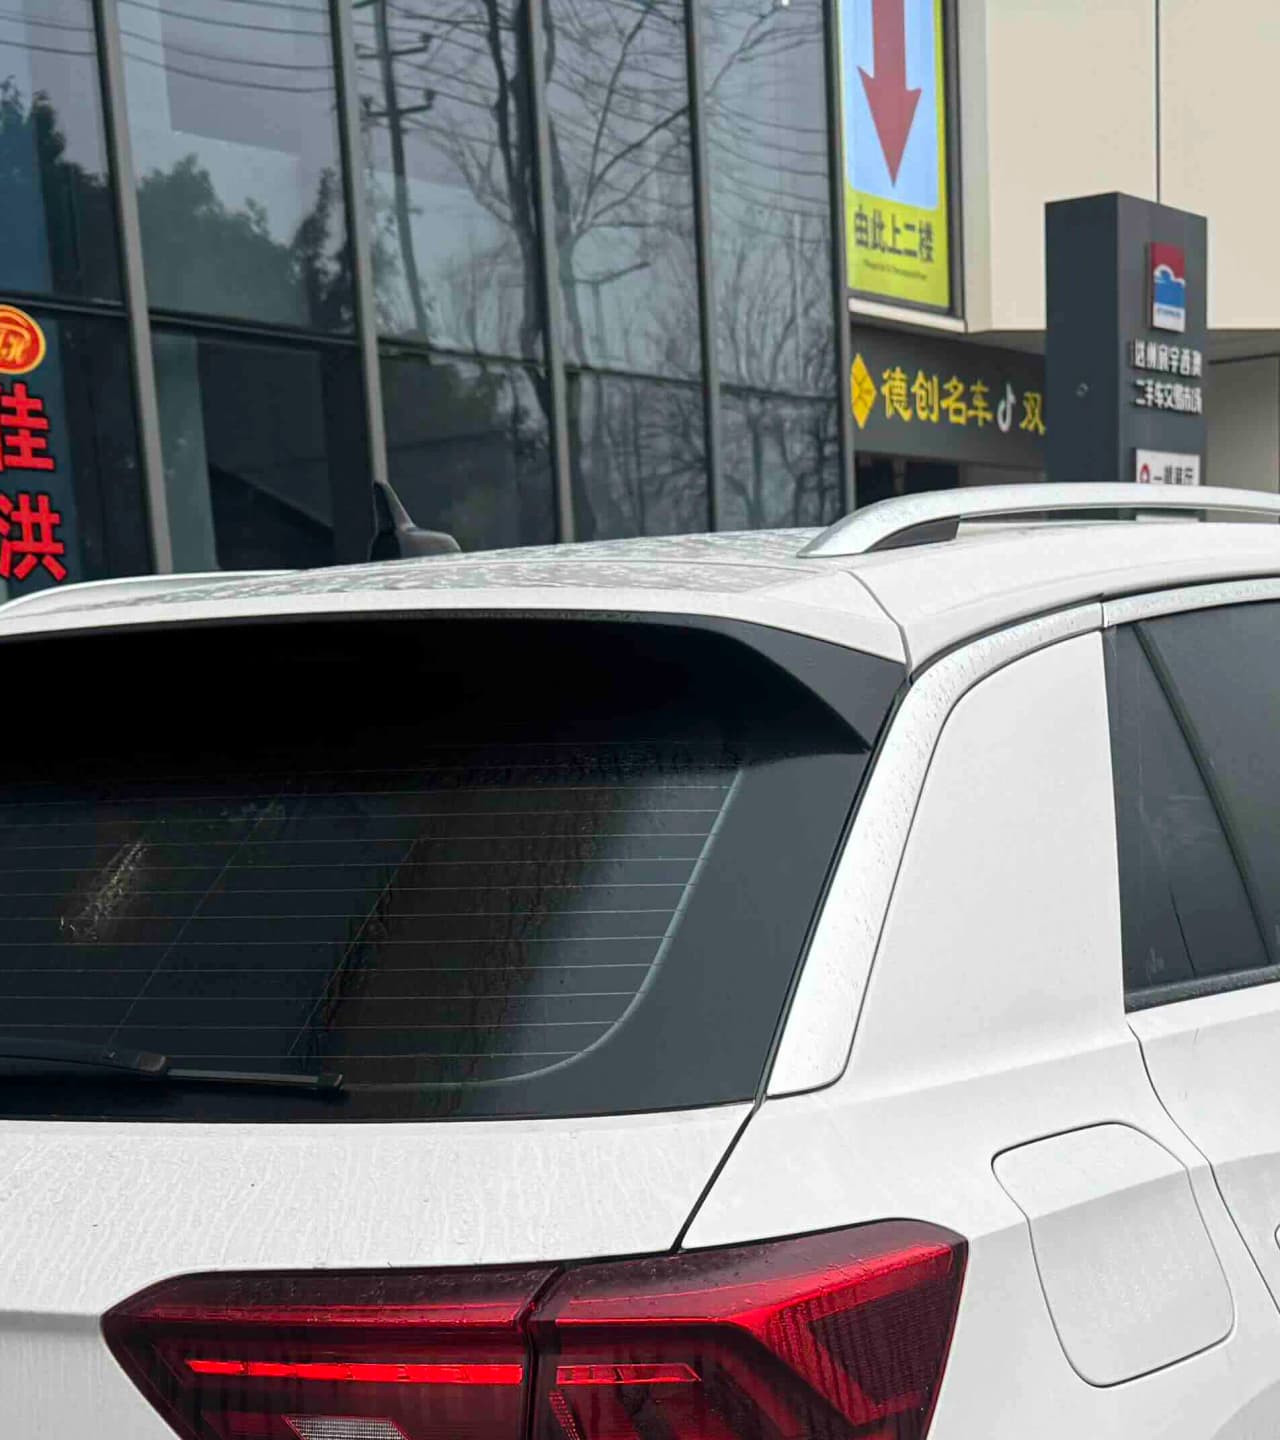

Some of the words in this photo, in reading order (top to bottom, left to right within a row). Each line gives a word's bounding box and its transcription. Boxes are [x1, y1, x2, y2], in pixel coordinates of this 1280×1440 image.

[854, 203, 934, 263] 由此上二楼
[880, 365, 994, 428] 德创名车
